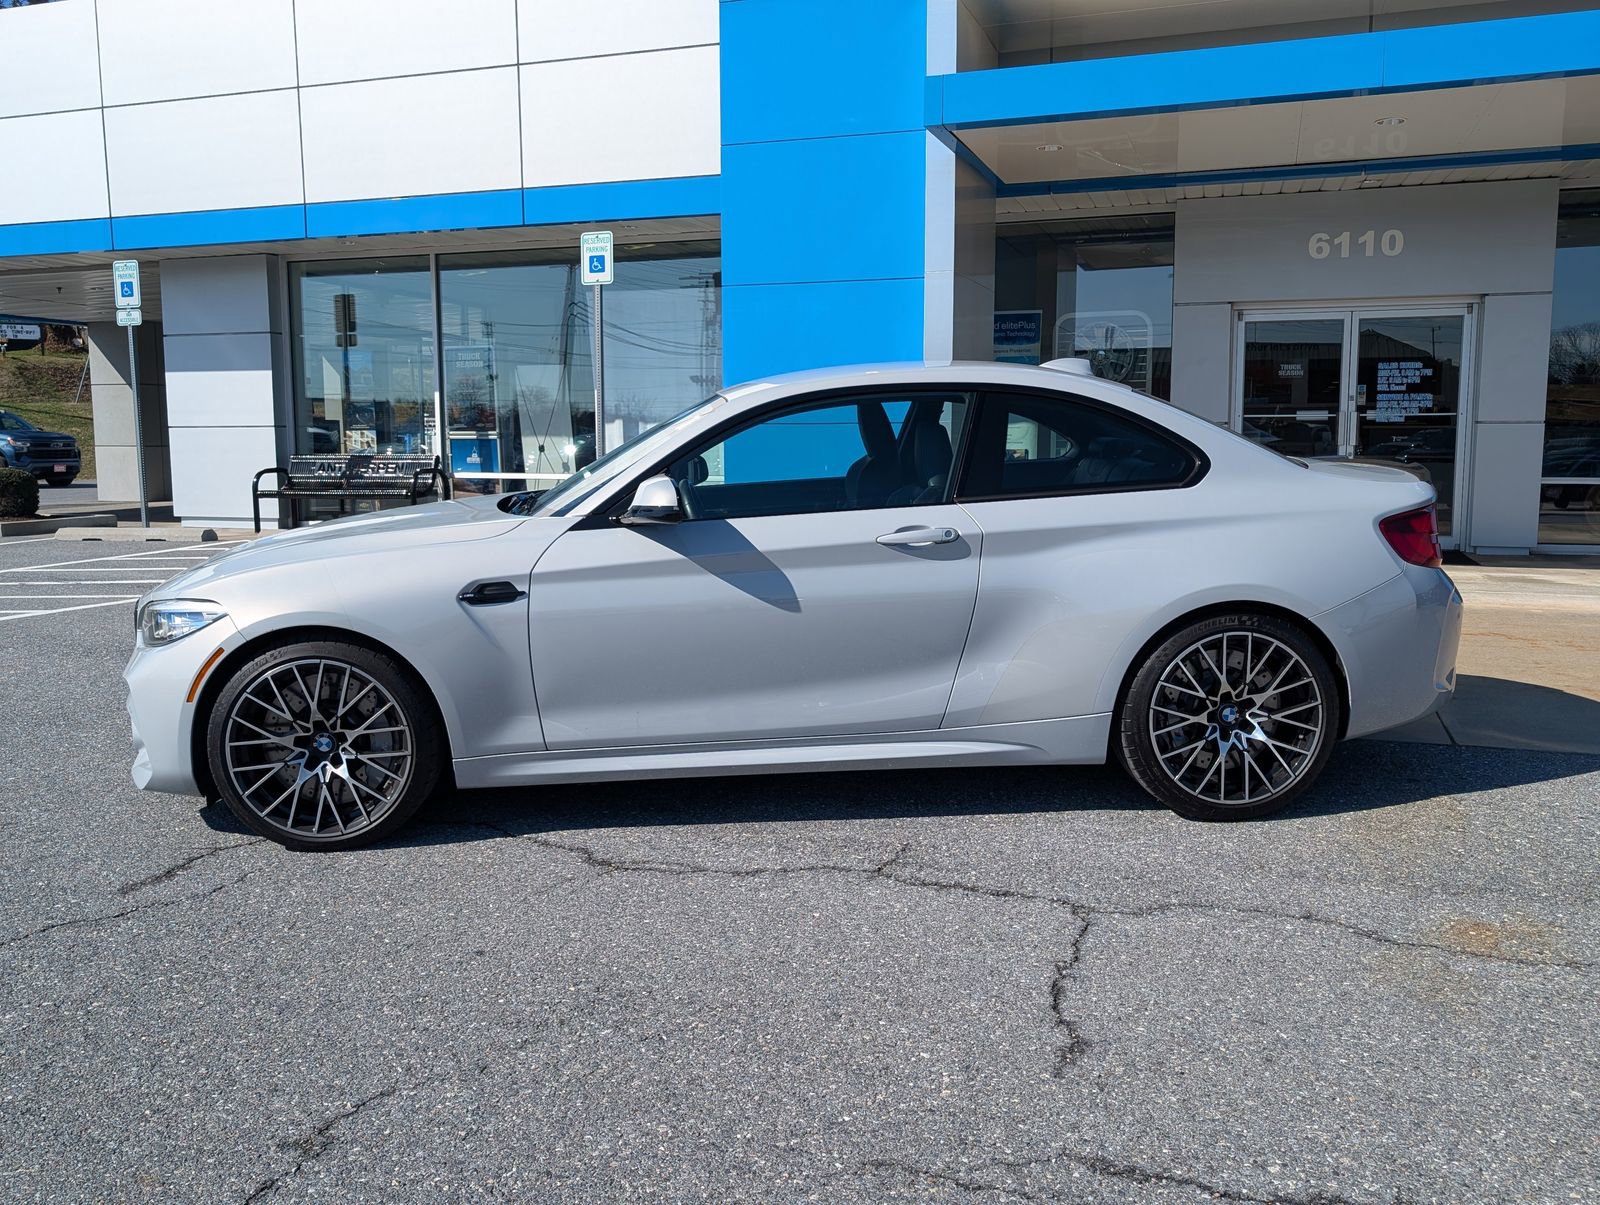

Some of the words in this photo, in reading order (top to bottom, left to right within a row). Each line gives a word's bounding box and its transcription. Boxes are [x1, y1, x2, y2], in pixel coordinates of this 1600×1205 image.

[583, 236, 610, 245] RESERVED
[1308, 229, 1404, 259] 6110
[586, 245, 609, 253] PARKING
[115, 264, 136, 272] RESERVED
[117, 272, 135, 280] PARKING
[457, 352, 481, 361] TRUCK
[455, 360, 484, 368] SEASON
[1278, 369, 1304, 377] SEASON
